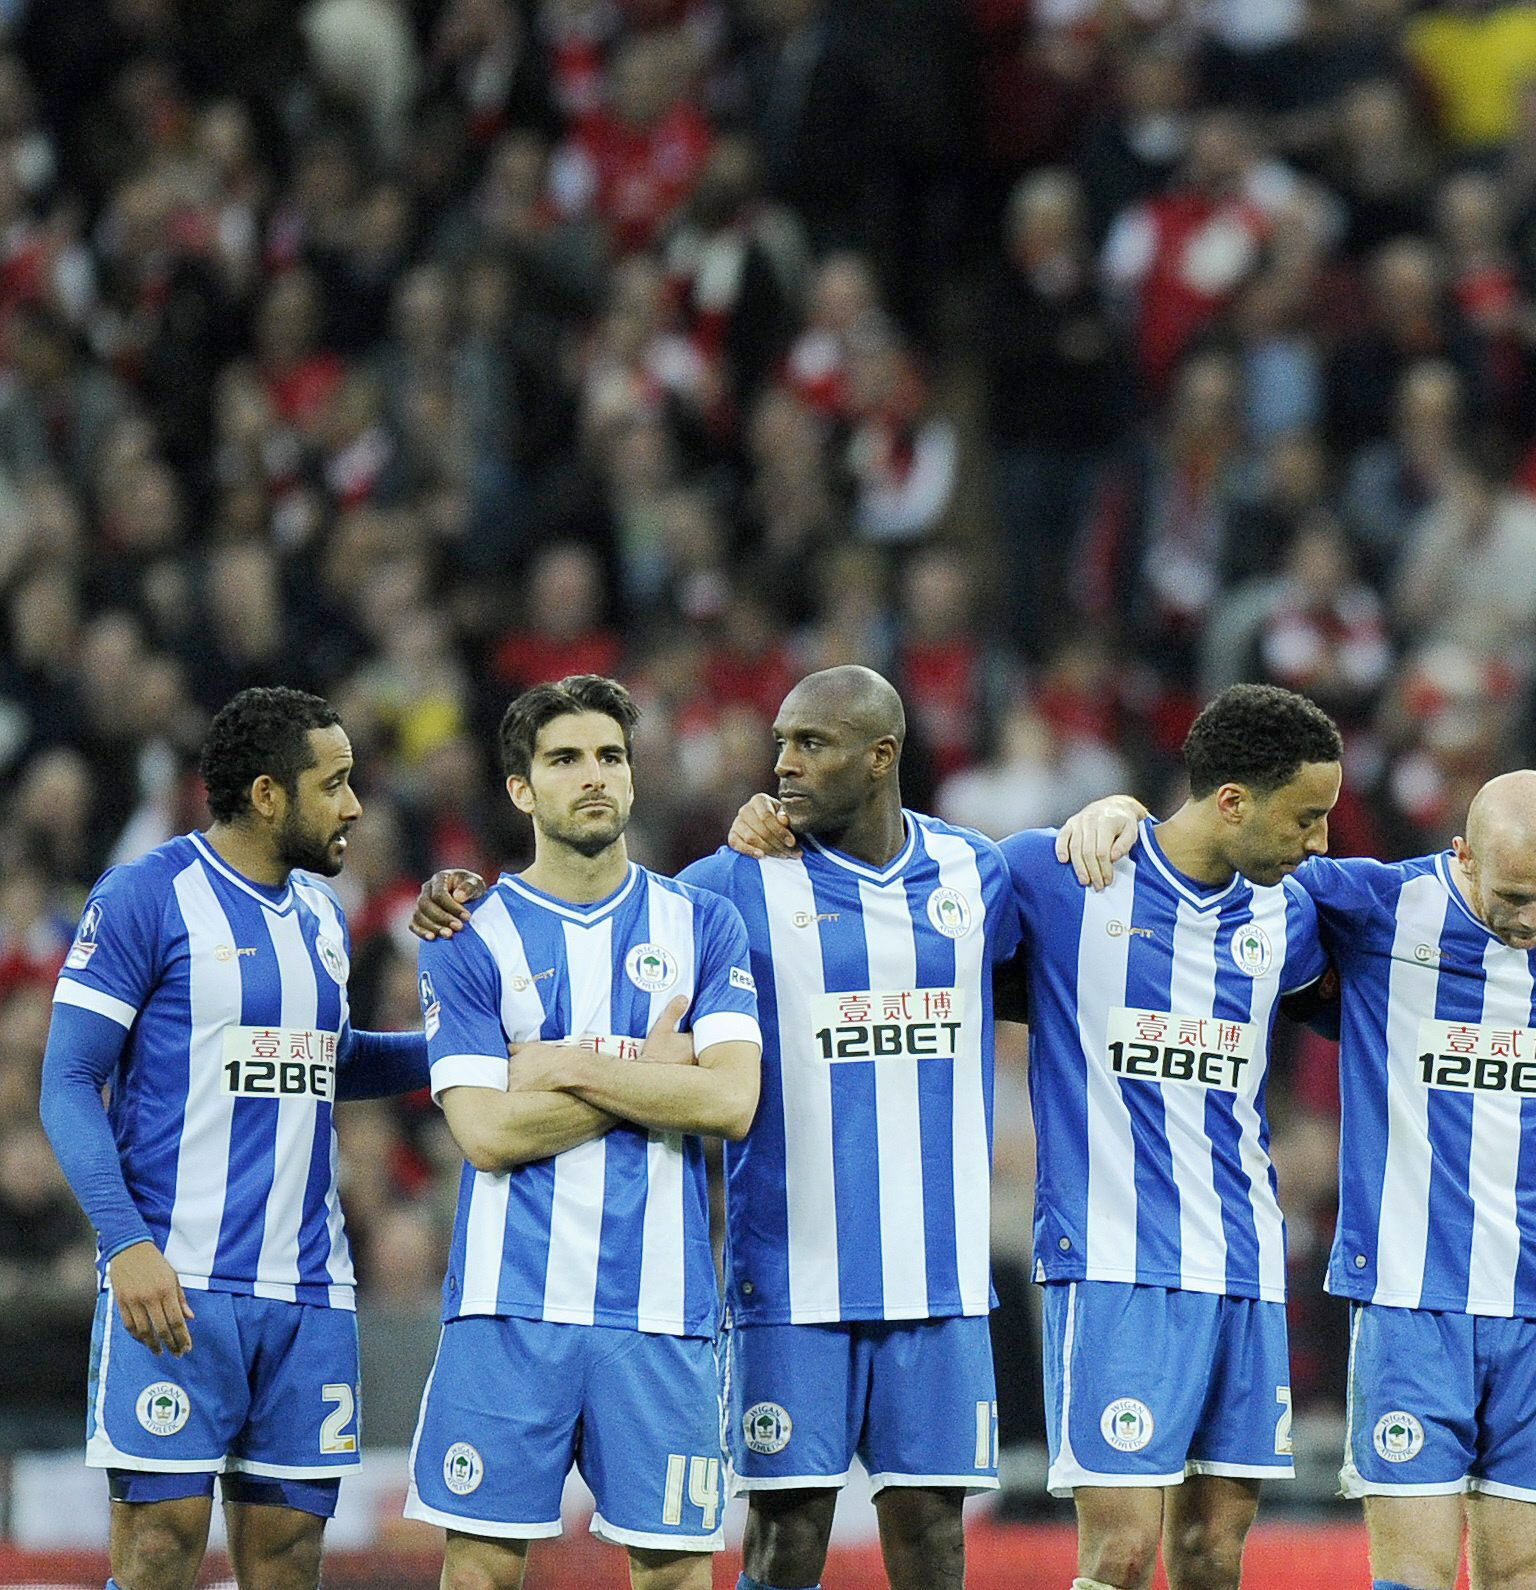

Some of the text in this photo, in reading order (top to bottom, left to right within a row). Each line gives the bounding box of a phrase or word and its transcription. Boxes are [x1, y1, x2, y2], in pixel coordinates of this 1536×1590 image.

[839, 991, 952, 1023] 壹贰博
[816, 1022, 961, 1059] 12BET
[1135, 1013, 1242, 1052] 壹贰博
[1108, 1041, 1249, 1088] 12BET
[319, 1384, 356, 1454] 2
[663, 1454, 719, 1529] 14
